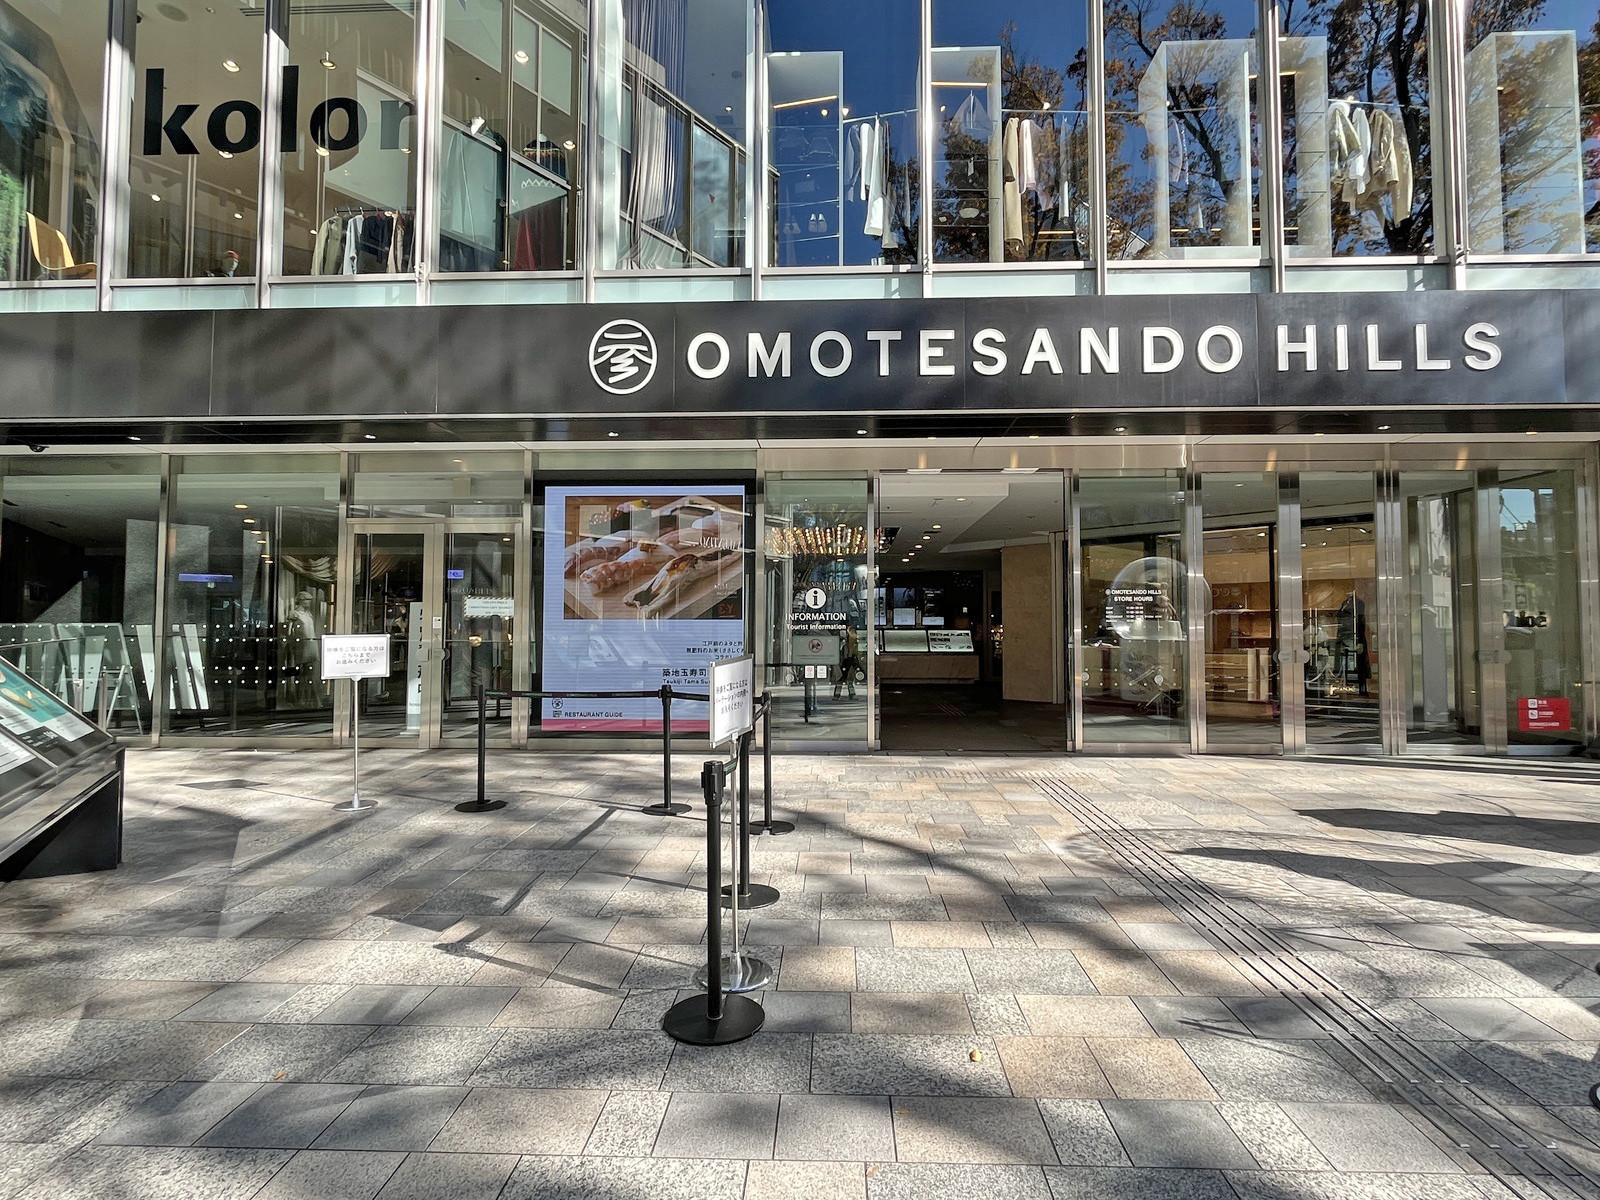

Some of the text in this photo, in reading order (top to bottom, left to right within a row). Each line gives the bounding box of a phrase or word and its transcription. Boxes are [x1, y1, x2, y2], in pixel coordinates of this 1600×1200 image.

[143, 65, 412, 156] kolor
[687, 322, 1501, 379] OMOTESANDO HILLS
[785, 612, 847, 621] INFORMATION
[662, 668, 707, 677] 築地玉寿司
